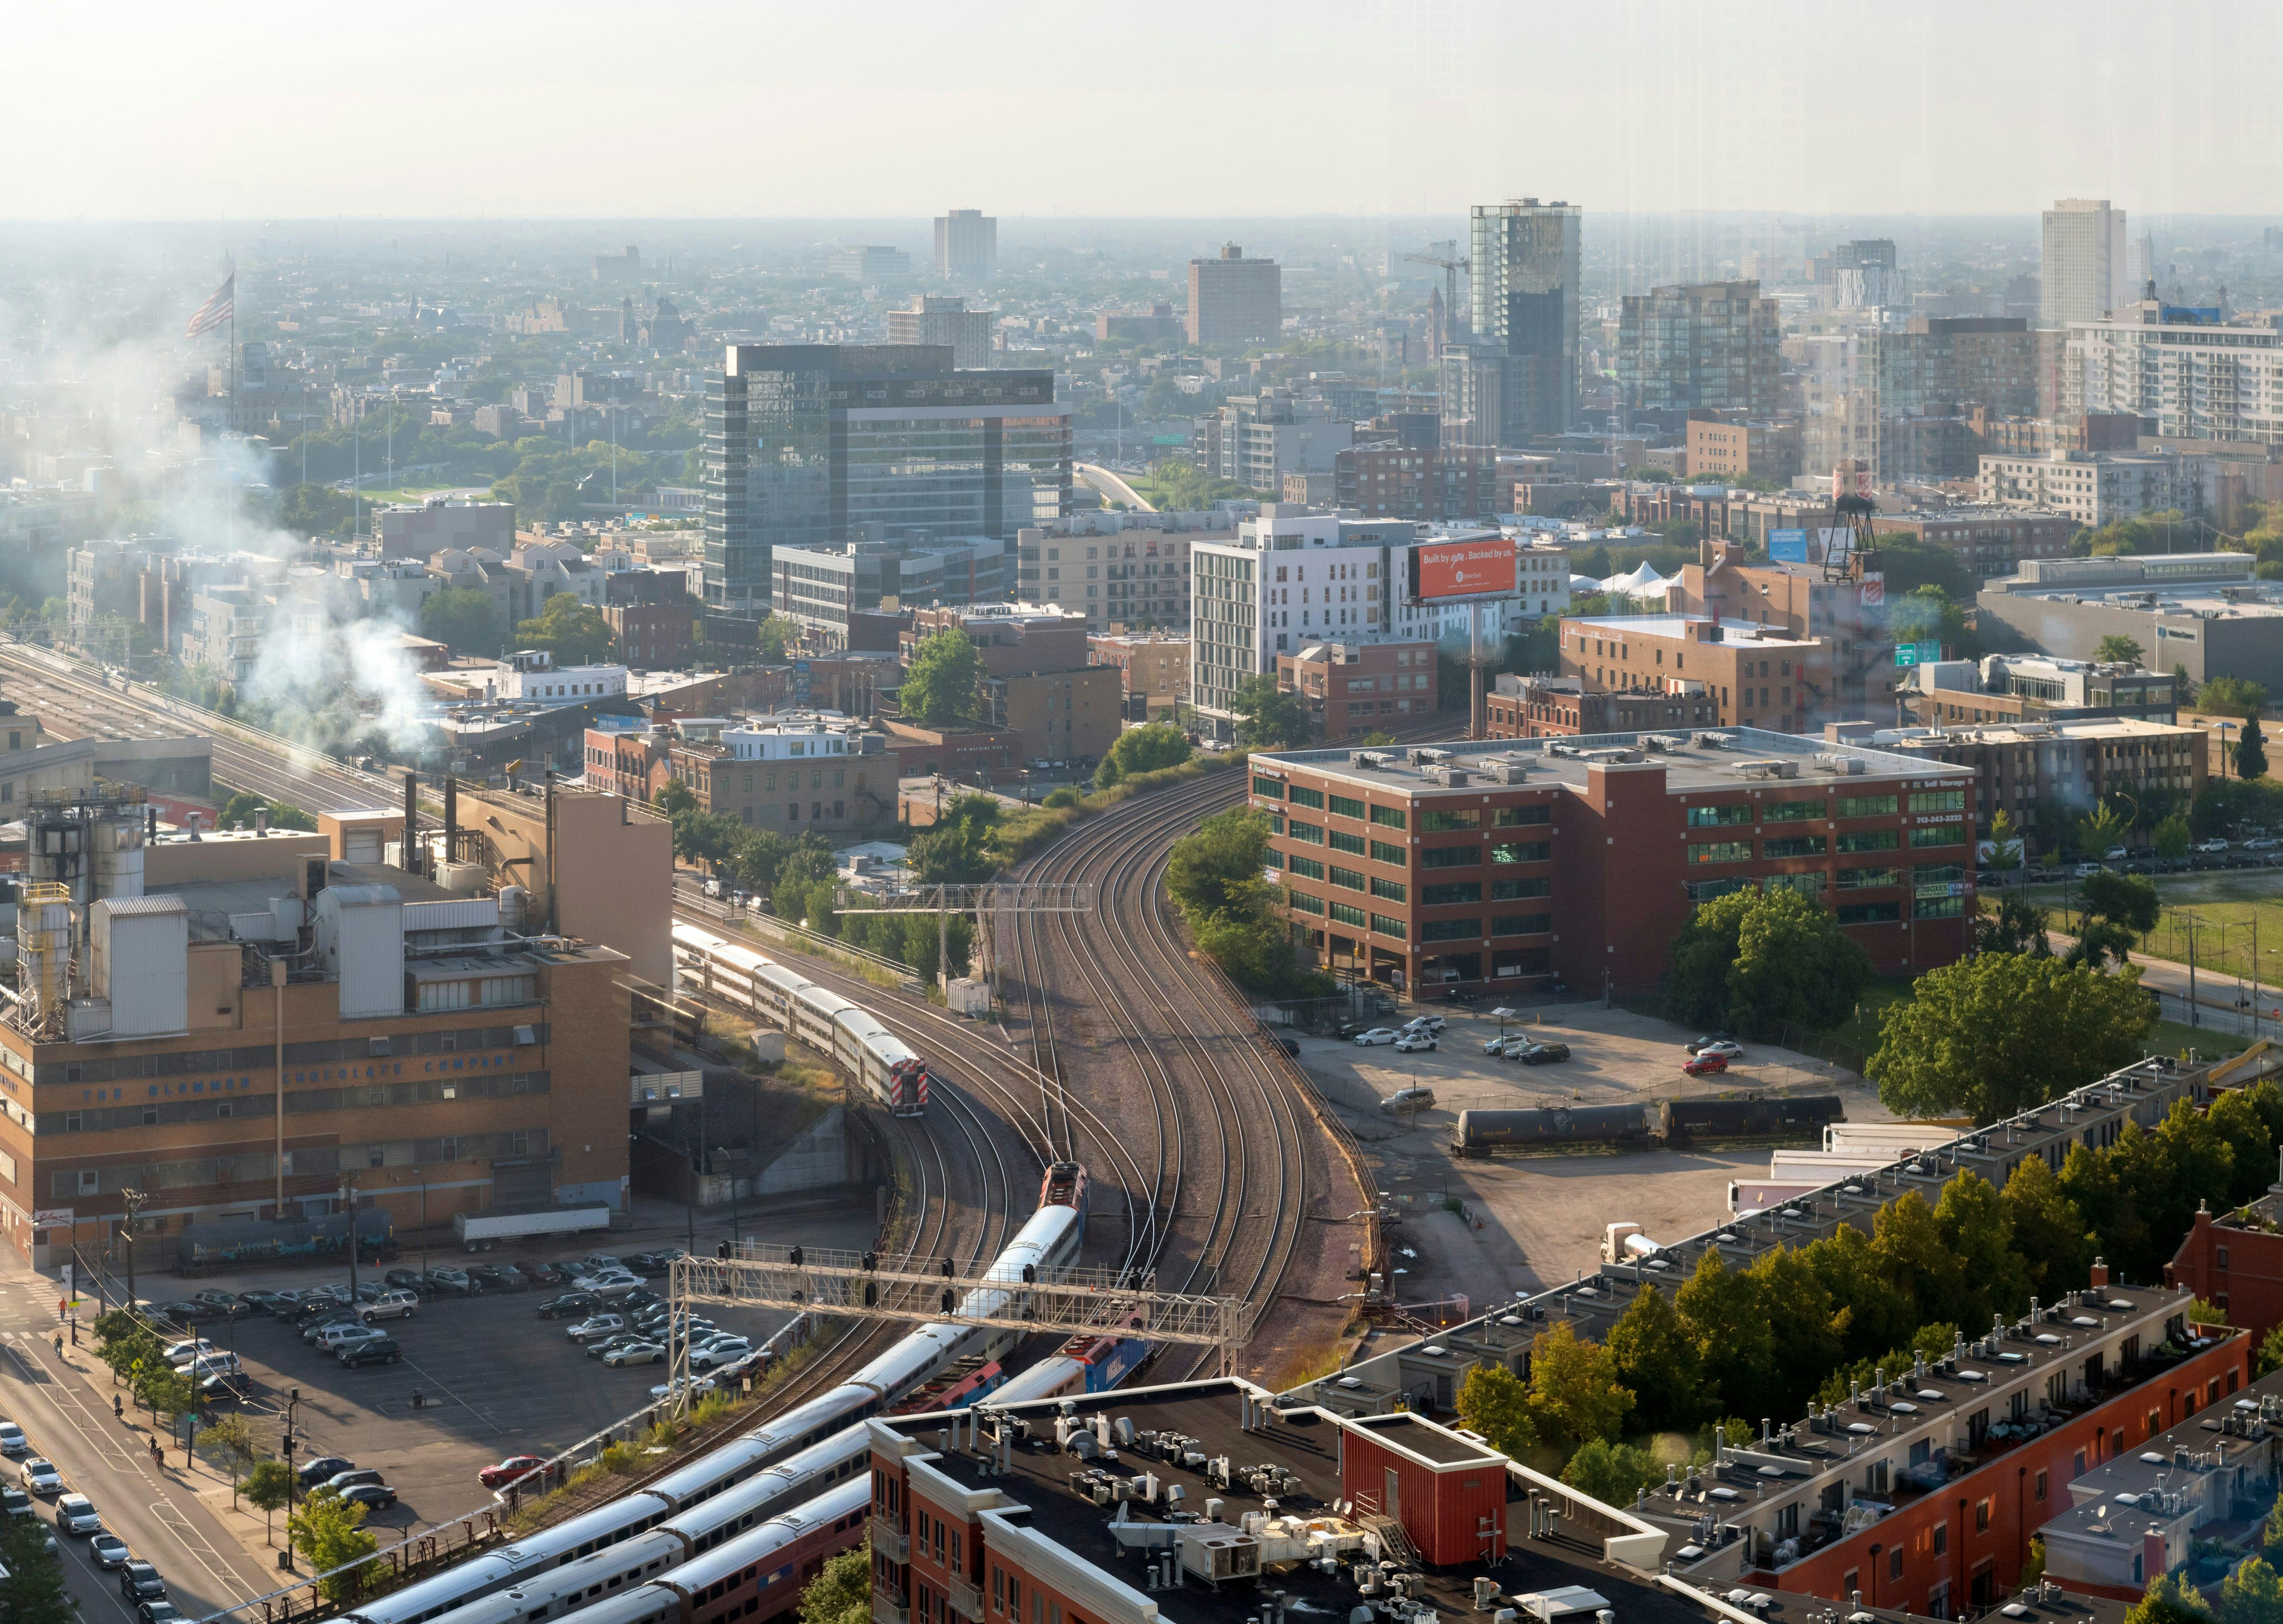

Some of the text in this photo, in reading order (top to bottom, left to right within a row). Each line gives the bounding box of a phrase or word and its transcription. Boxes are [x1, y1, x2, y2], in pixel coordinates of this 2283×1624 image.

[1423, 554, 1439, 564] Built
[1441, 553, 1449, 564] by
[1468, 550, 1493, 560] Backed
[1494, 549, 1502, 559] by
[1599, 631, 1619, 640] STORE
[1257, 766, 1266, 775] Self
[1266, 768, 1281, 778] Storage
[1916, 814, 1963, 824] 312-243-2222
[1926, 884, 1948, 892] BOXES
[82, 1053, 516, 1103] THE BLOMMER CHOCOLATE COMPANY
[1106, 1355, 1124, 1384] Metra
